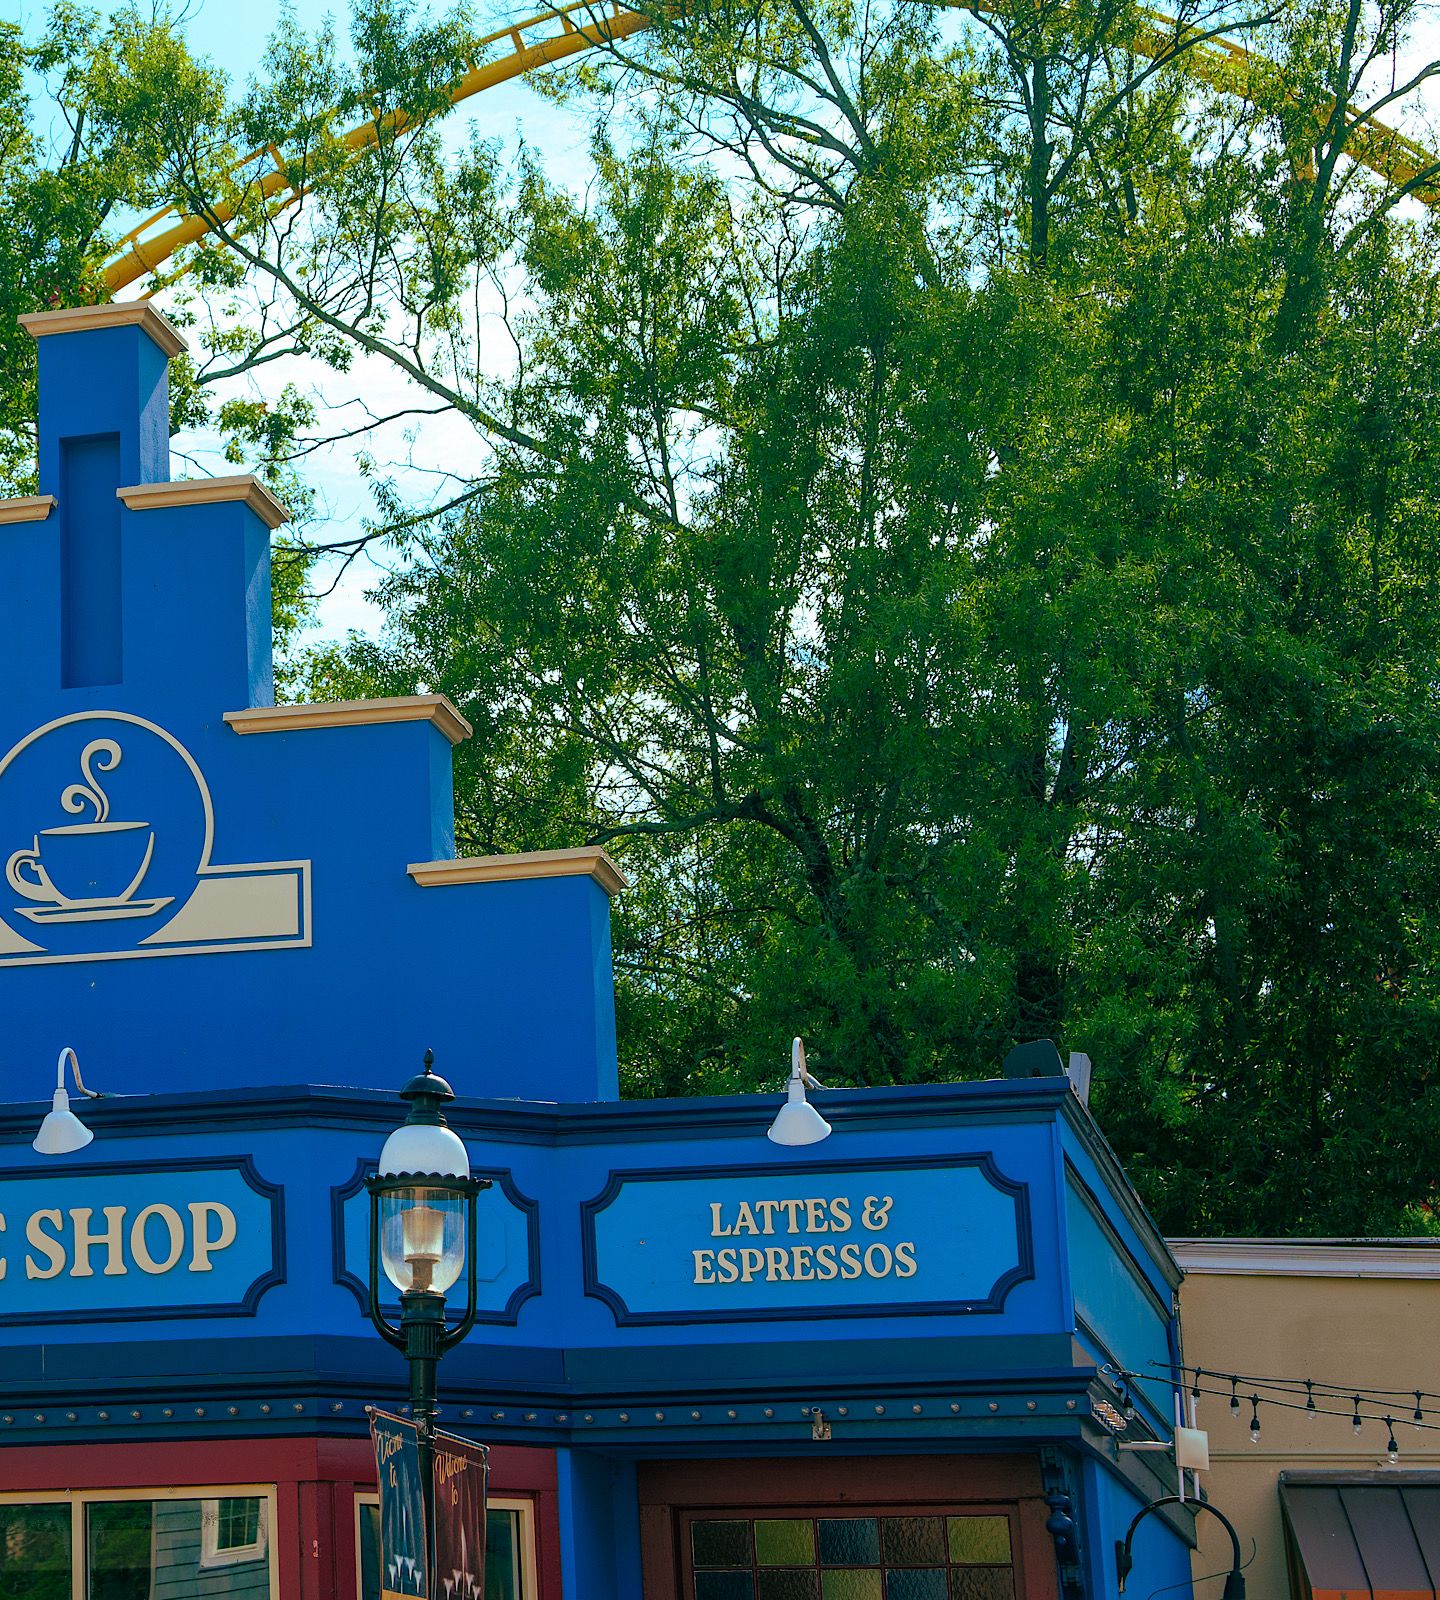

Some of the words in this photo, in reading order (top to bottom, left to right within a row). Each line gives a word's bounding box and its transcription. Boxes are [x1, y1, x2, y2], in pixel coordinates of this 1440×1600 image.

[709, 1196, 853, 1237] LATTES
[861, 1195, 894, 1231] &
[25, 1201, 238, 1280] SHOP
[691, 1241, 918, 1285] ESPRESSOS
